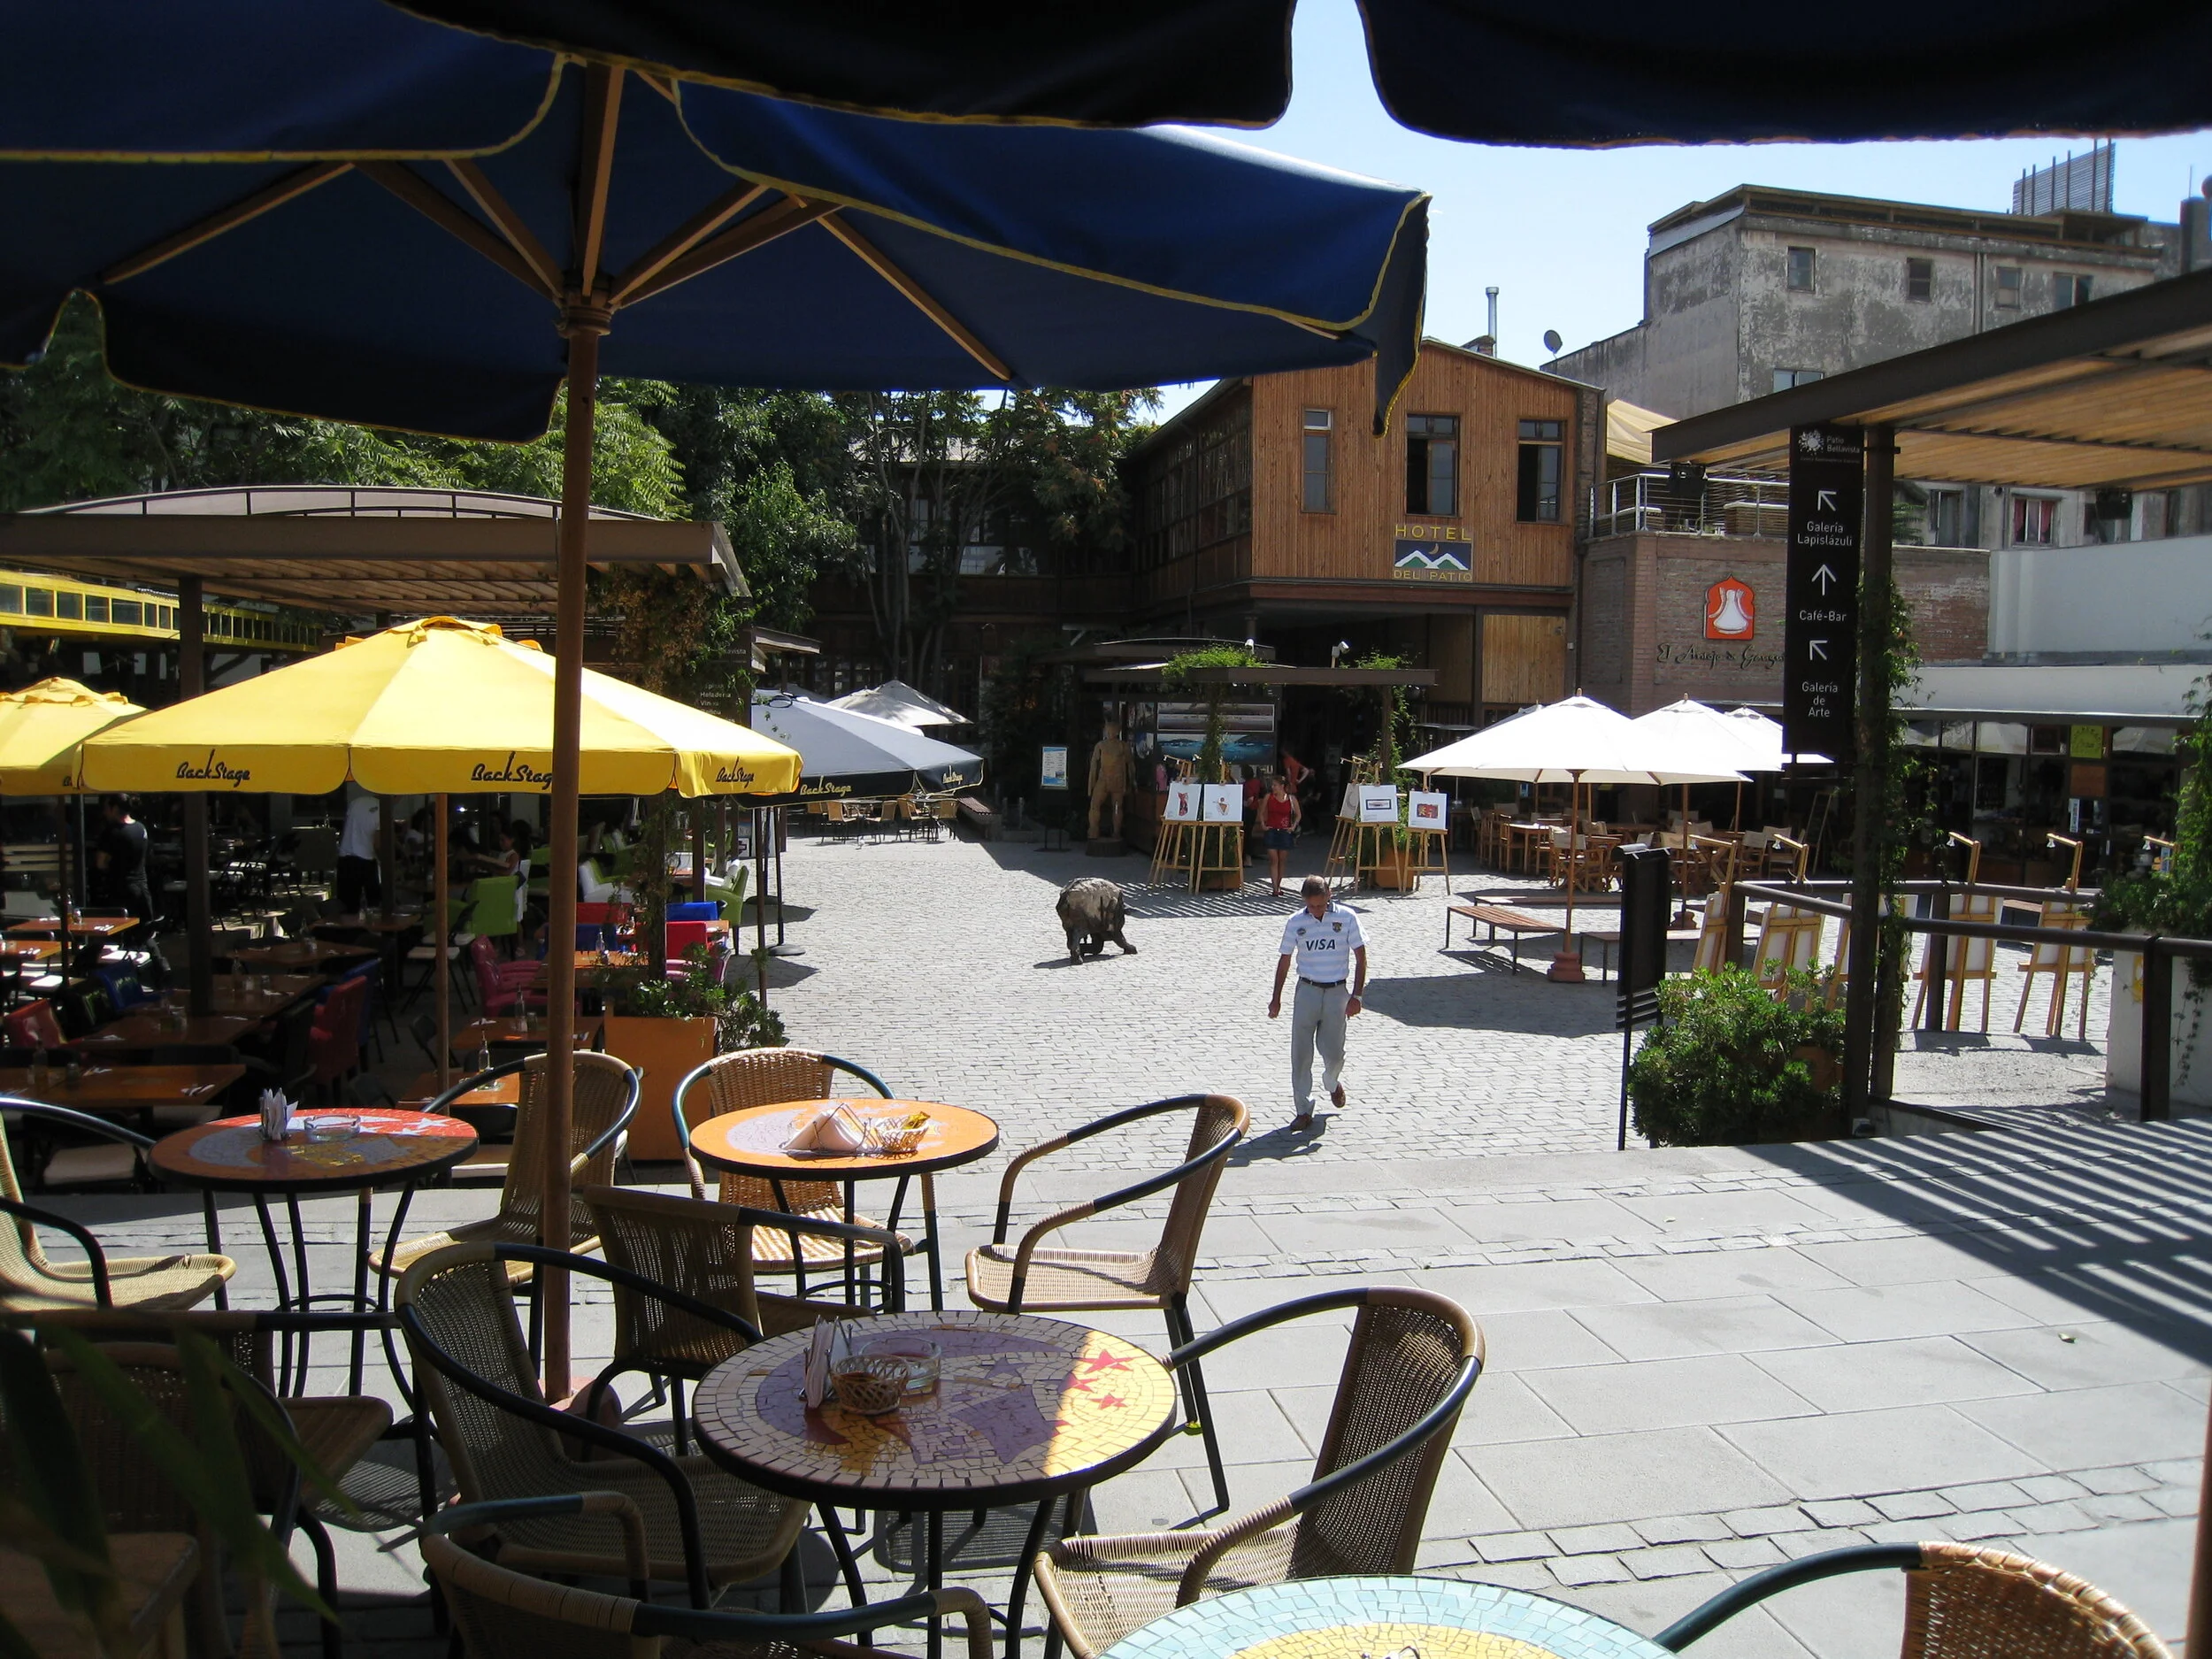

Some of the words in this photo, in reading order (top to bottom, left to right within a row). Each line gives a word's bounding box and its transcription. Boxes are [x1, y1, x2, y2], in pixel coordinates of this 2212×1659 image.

[1826, 435, 1845, 444] Patio
[1826, 444, 1861, 453] Bellavista
[1394, 524, 1472, 541] HOTEL
[1807, 520, 1844, 533] Galería
[1797, 533, 1853, 547] Lapislázuli
[1394, 569, 1420, 580] DEL
[1429, 571, 1472, 581] PATIO
[1799, 610, 1847, 621] Café-Bar
[1801, 680, 1838, 693] Galería
[1813, 695, 1825, 705] de
[1808, 706, 1830, 717] Arte
[175, 748, 250, 788] BackStage
[471, 750, 553, 790] BackStag
[715, 755, 755, 788] BackStage
[800, 775, 852, 797] BackStage
[1305, 939, 1336, 951] VISA
